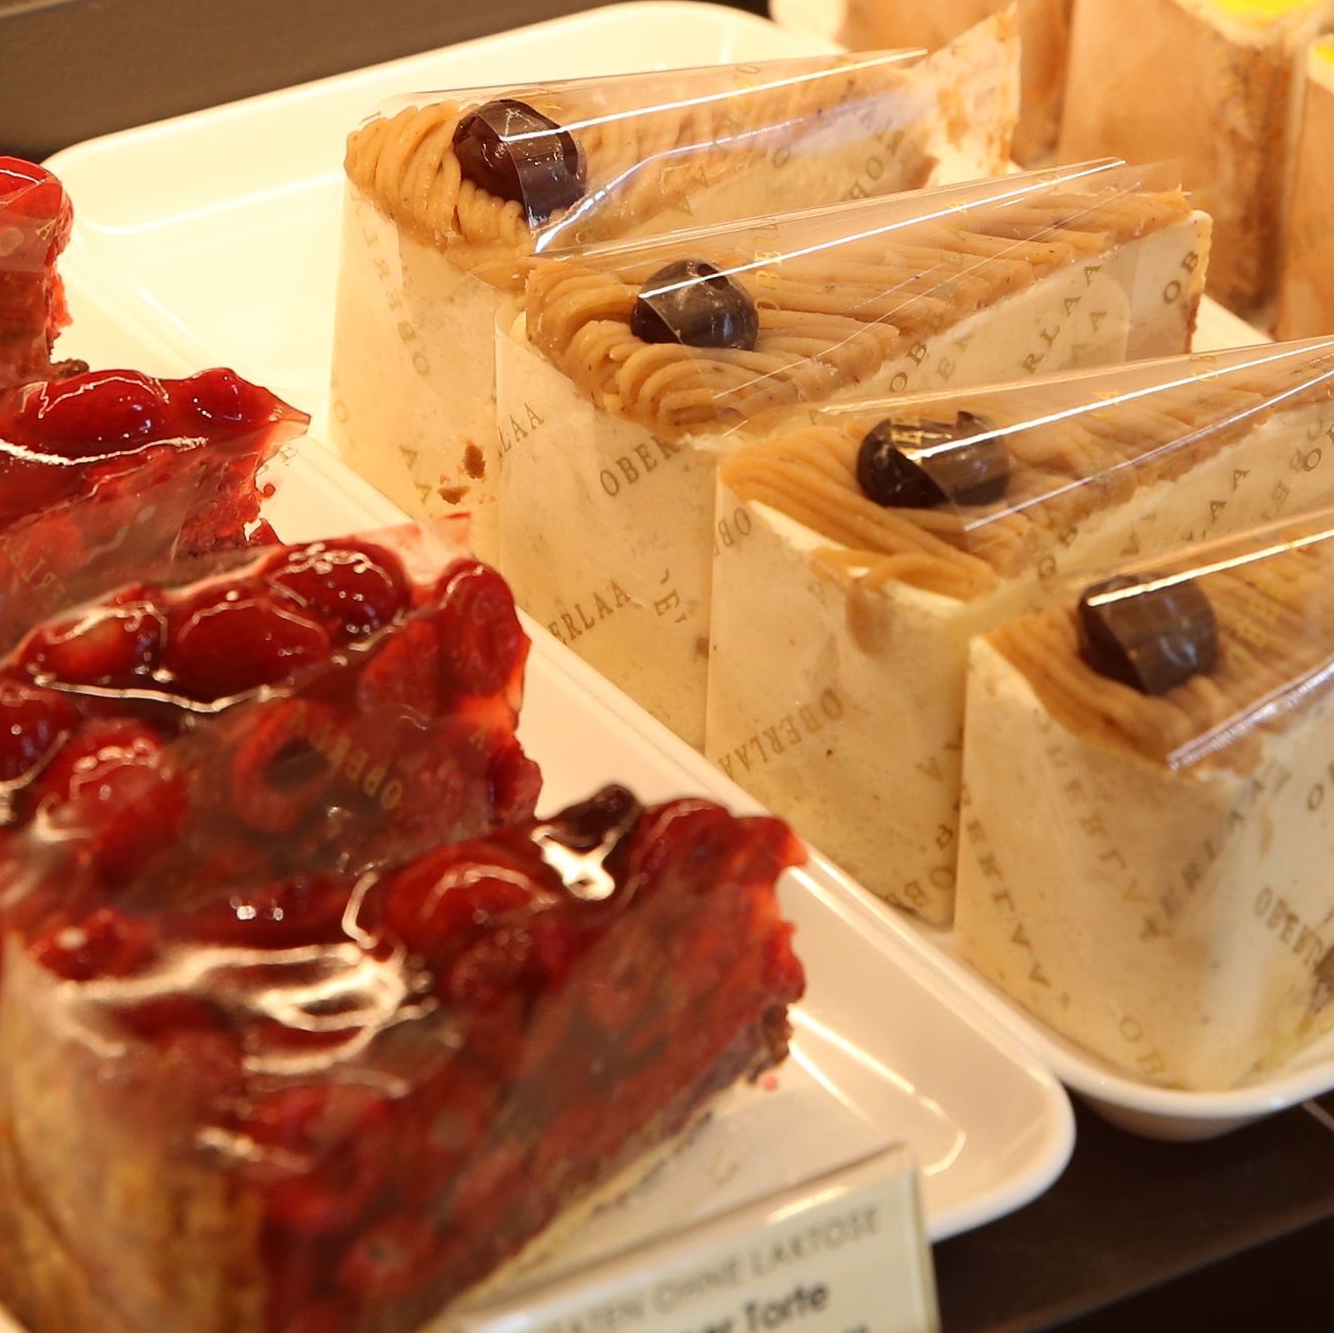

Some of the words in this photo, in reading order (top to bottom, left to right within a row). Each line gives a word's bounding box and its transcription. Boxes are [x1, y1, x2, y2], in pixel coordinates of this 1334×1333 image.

[599, 429, 677, 497] OBER
[717, 688, 844, 782] OBERLAA
[652, 1255, 742, 1314] OHNE
[753, 1207, 880, 1275] LAKTOSE
[742, 1280, 832, 1333] Torte
